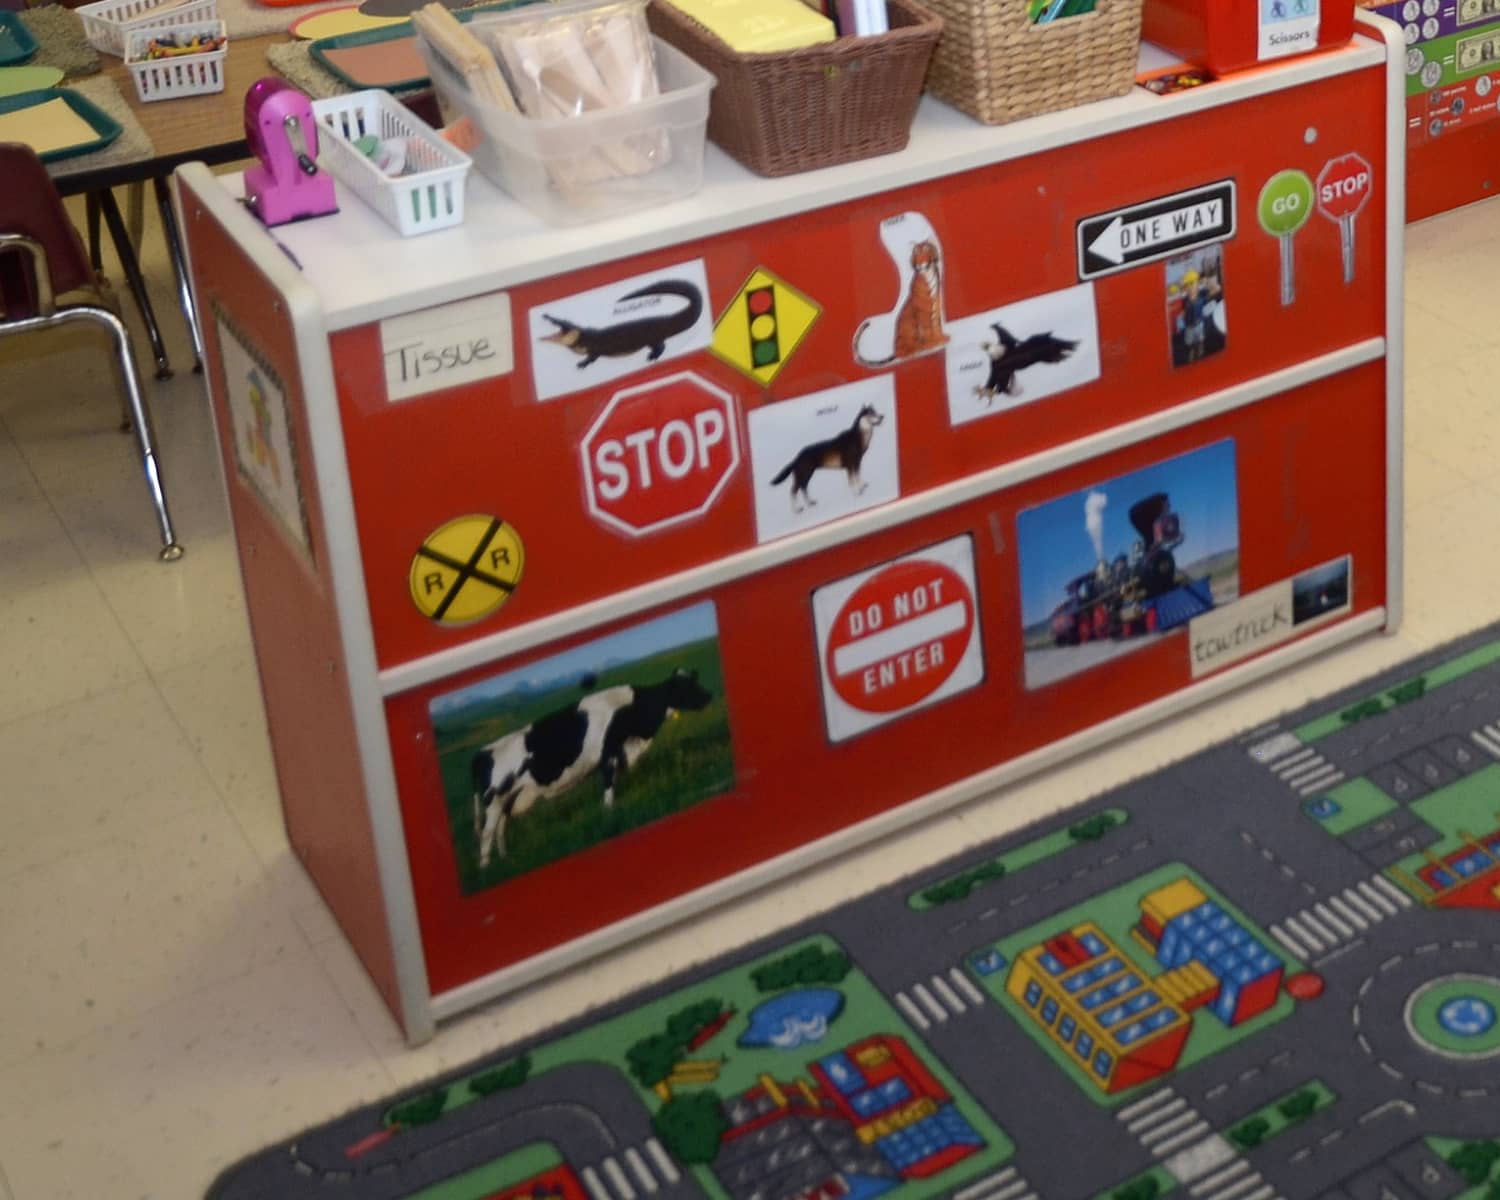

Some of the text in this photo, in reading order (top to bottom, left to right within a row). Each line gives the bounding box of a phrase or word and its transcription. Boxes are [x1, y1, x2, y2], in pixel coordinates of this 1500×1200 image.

[1268, 30, 1310, 46] Scissors
[1271, 191, 1301, 216] GO
[1320, 171, 1369, 203] STOP
[1119, 201, 1220, 249] ONE WAY
[386, 339, 497, 383] Tissue
[598, 408, 725, 500] STOP
[490, 547, 511, 569] R
[424, 571, 445, 596] R
[848, 578, 945, 637] DO NOT
[862, 644, 946, 698] ENTER
